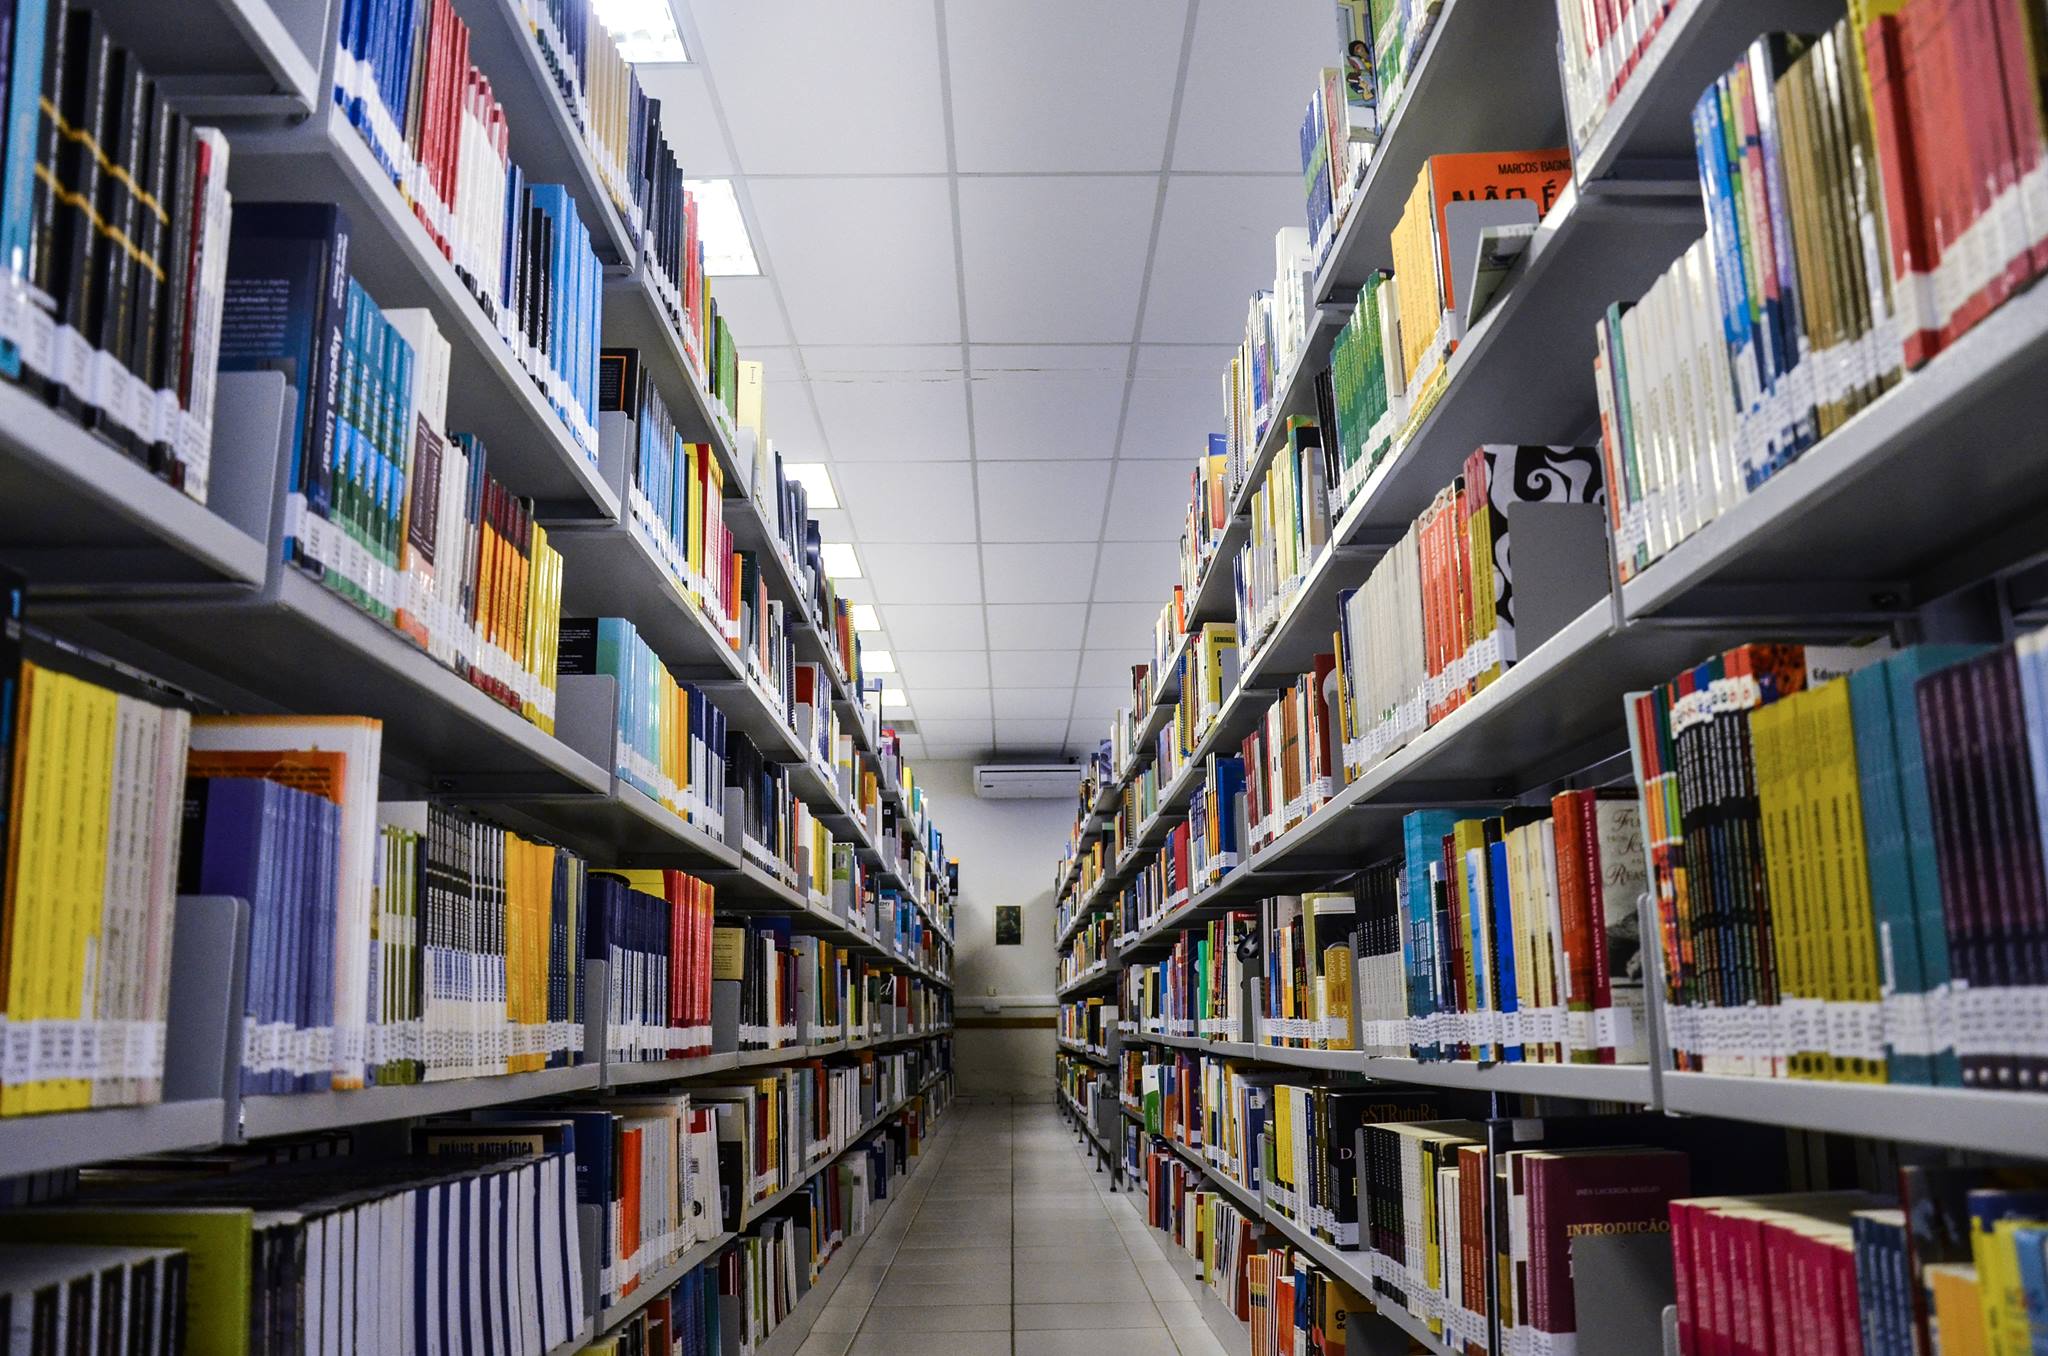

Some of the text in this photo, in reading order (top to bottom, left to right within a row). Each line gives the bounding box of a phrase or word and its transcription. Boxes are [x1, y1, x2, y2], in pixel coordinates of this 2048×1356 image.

[1498, 162, 1538, 175] MARCOS
[328, 326, 343, 405] Algebra
[322, 409, 336, 474] Linear
[1585, 821, 1593, 854] FLIGHT
[1590, 887, 1598, 922] SCIENCE
[1595, 949, 1603, 988] REASON
[478, 1140, 534, 1154] MATEMÁTICA
[1594, 1187, 1628, 1195] LACERDA
